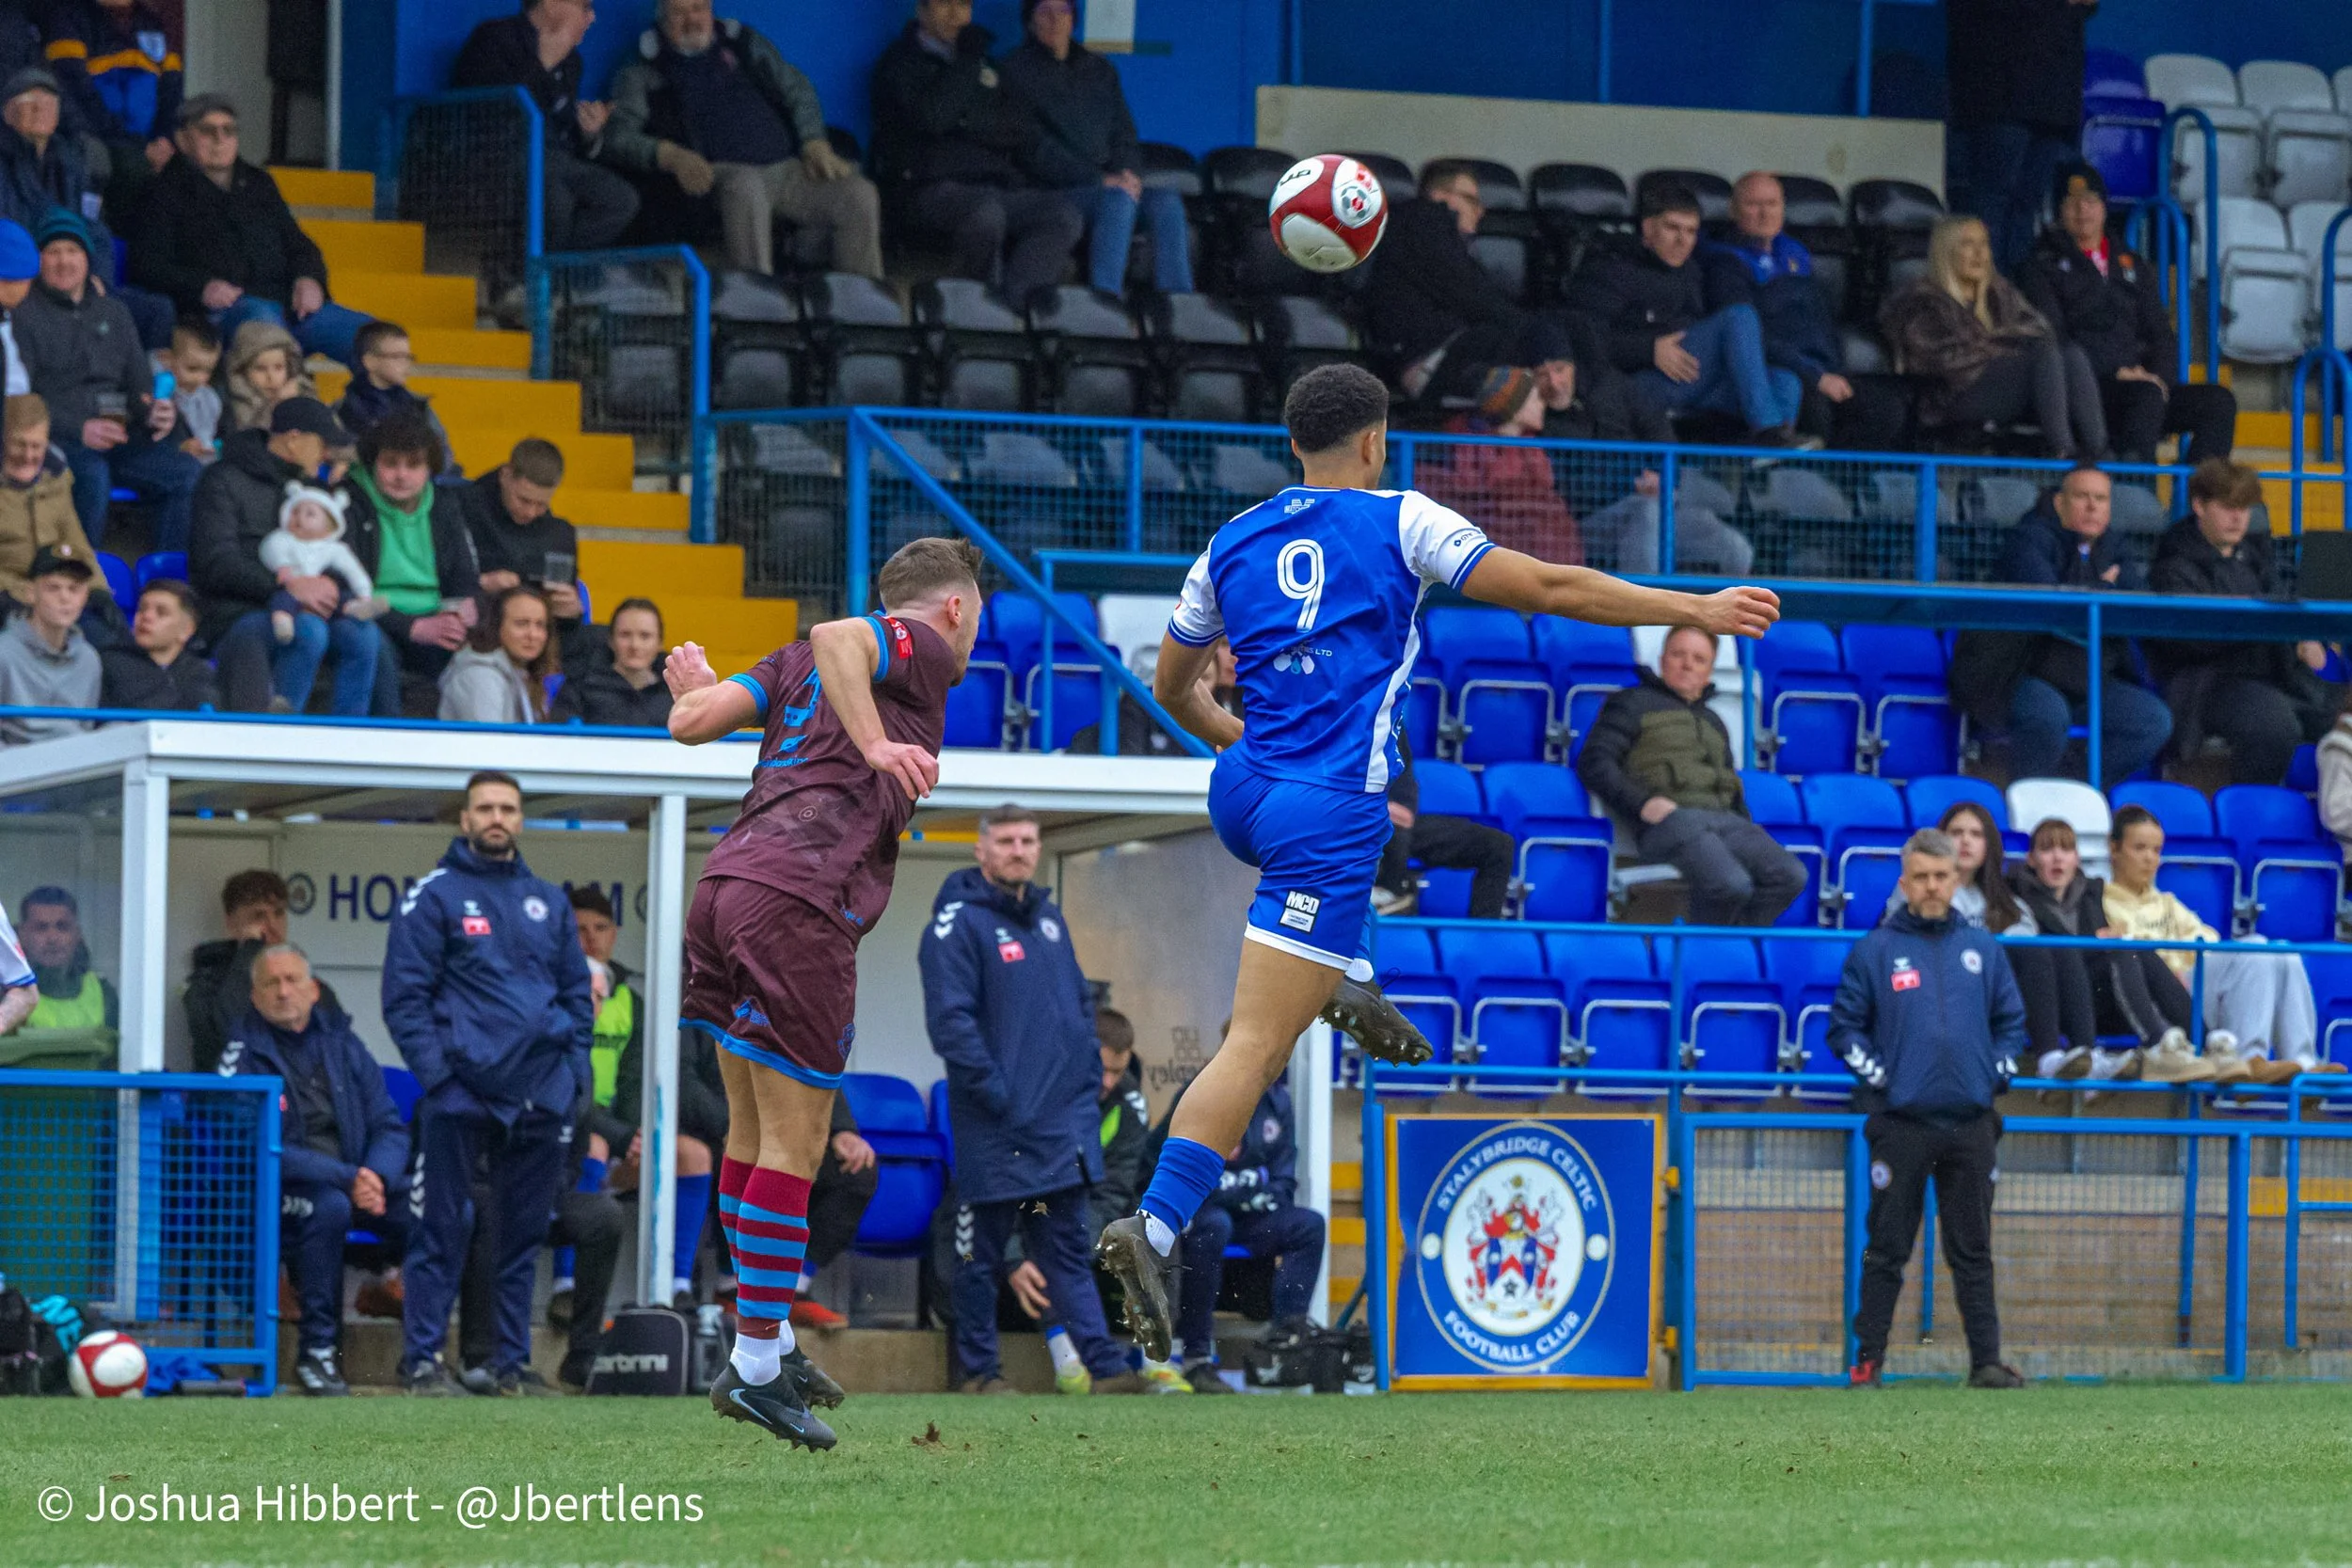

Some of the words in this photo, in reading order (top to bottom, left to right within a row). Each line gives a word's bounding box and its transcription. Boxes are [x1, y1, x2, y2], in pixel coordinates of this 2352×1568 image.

[1277, 538, 1326, 633] 9
[1315, 648, 1332, 657] LTD
[329, 874, 416, 922] HO
[1286, 891, 1320, 914] MCD
[1438, 1136, 1551, 1211] STALYBRIDGE
[1552, 1148, 1597, 1212] CELTIC
[1444, 1310, 1534, 1363] FOOTBALL
[1534, 1310, 1581, 1354] CLUB
